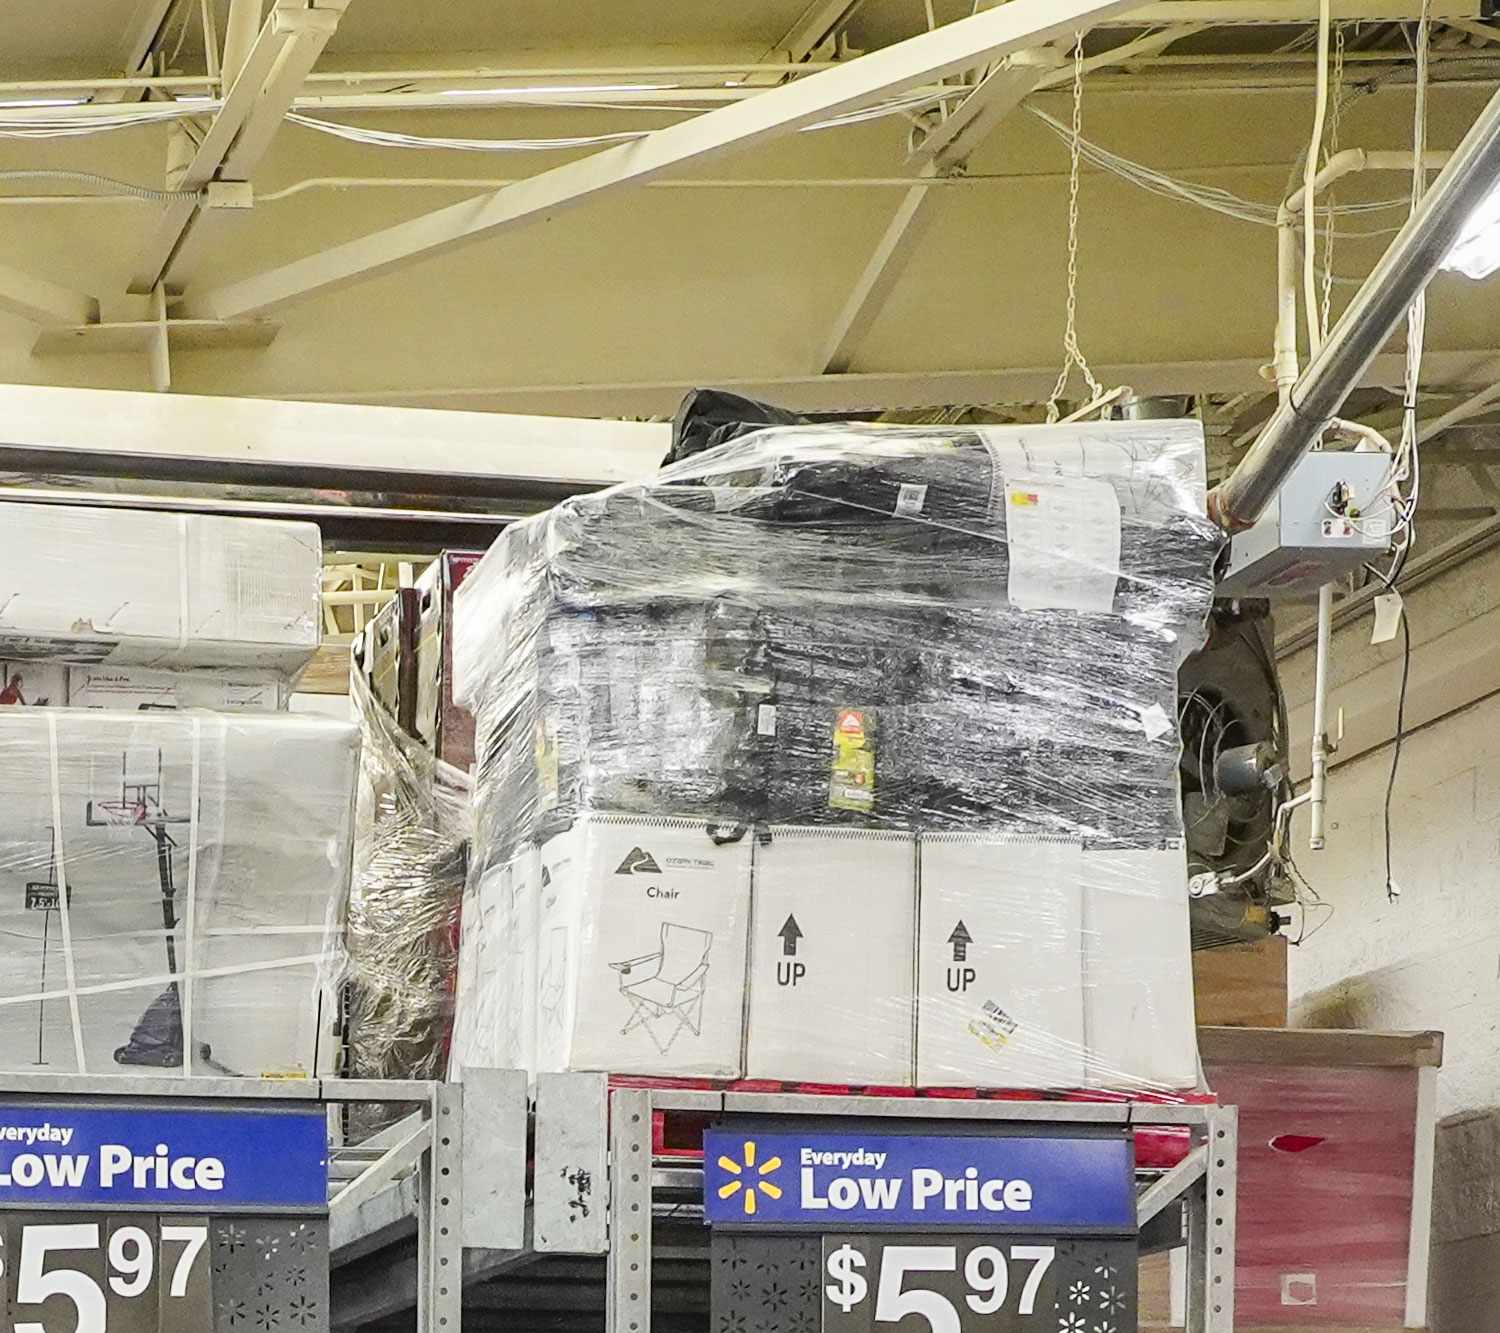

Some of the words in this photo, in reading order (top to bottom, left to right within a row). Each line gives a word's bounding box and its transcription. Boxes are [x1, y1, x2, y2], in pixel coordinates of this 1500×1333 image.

[646, 886, 680, 900] Chair
[776, 962, 807, 987] UP
[946, 968, 977, 992] UP
[100, 1143, 226, 1190] Price
[800, 1147, 887, 1171] Everyday
[800, 1167, 902, 1210] Low
[912, 1166, 1033, 1212] Price
